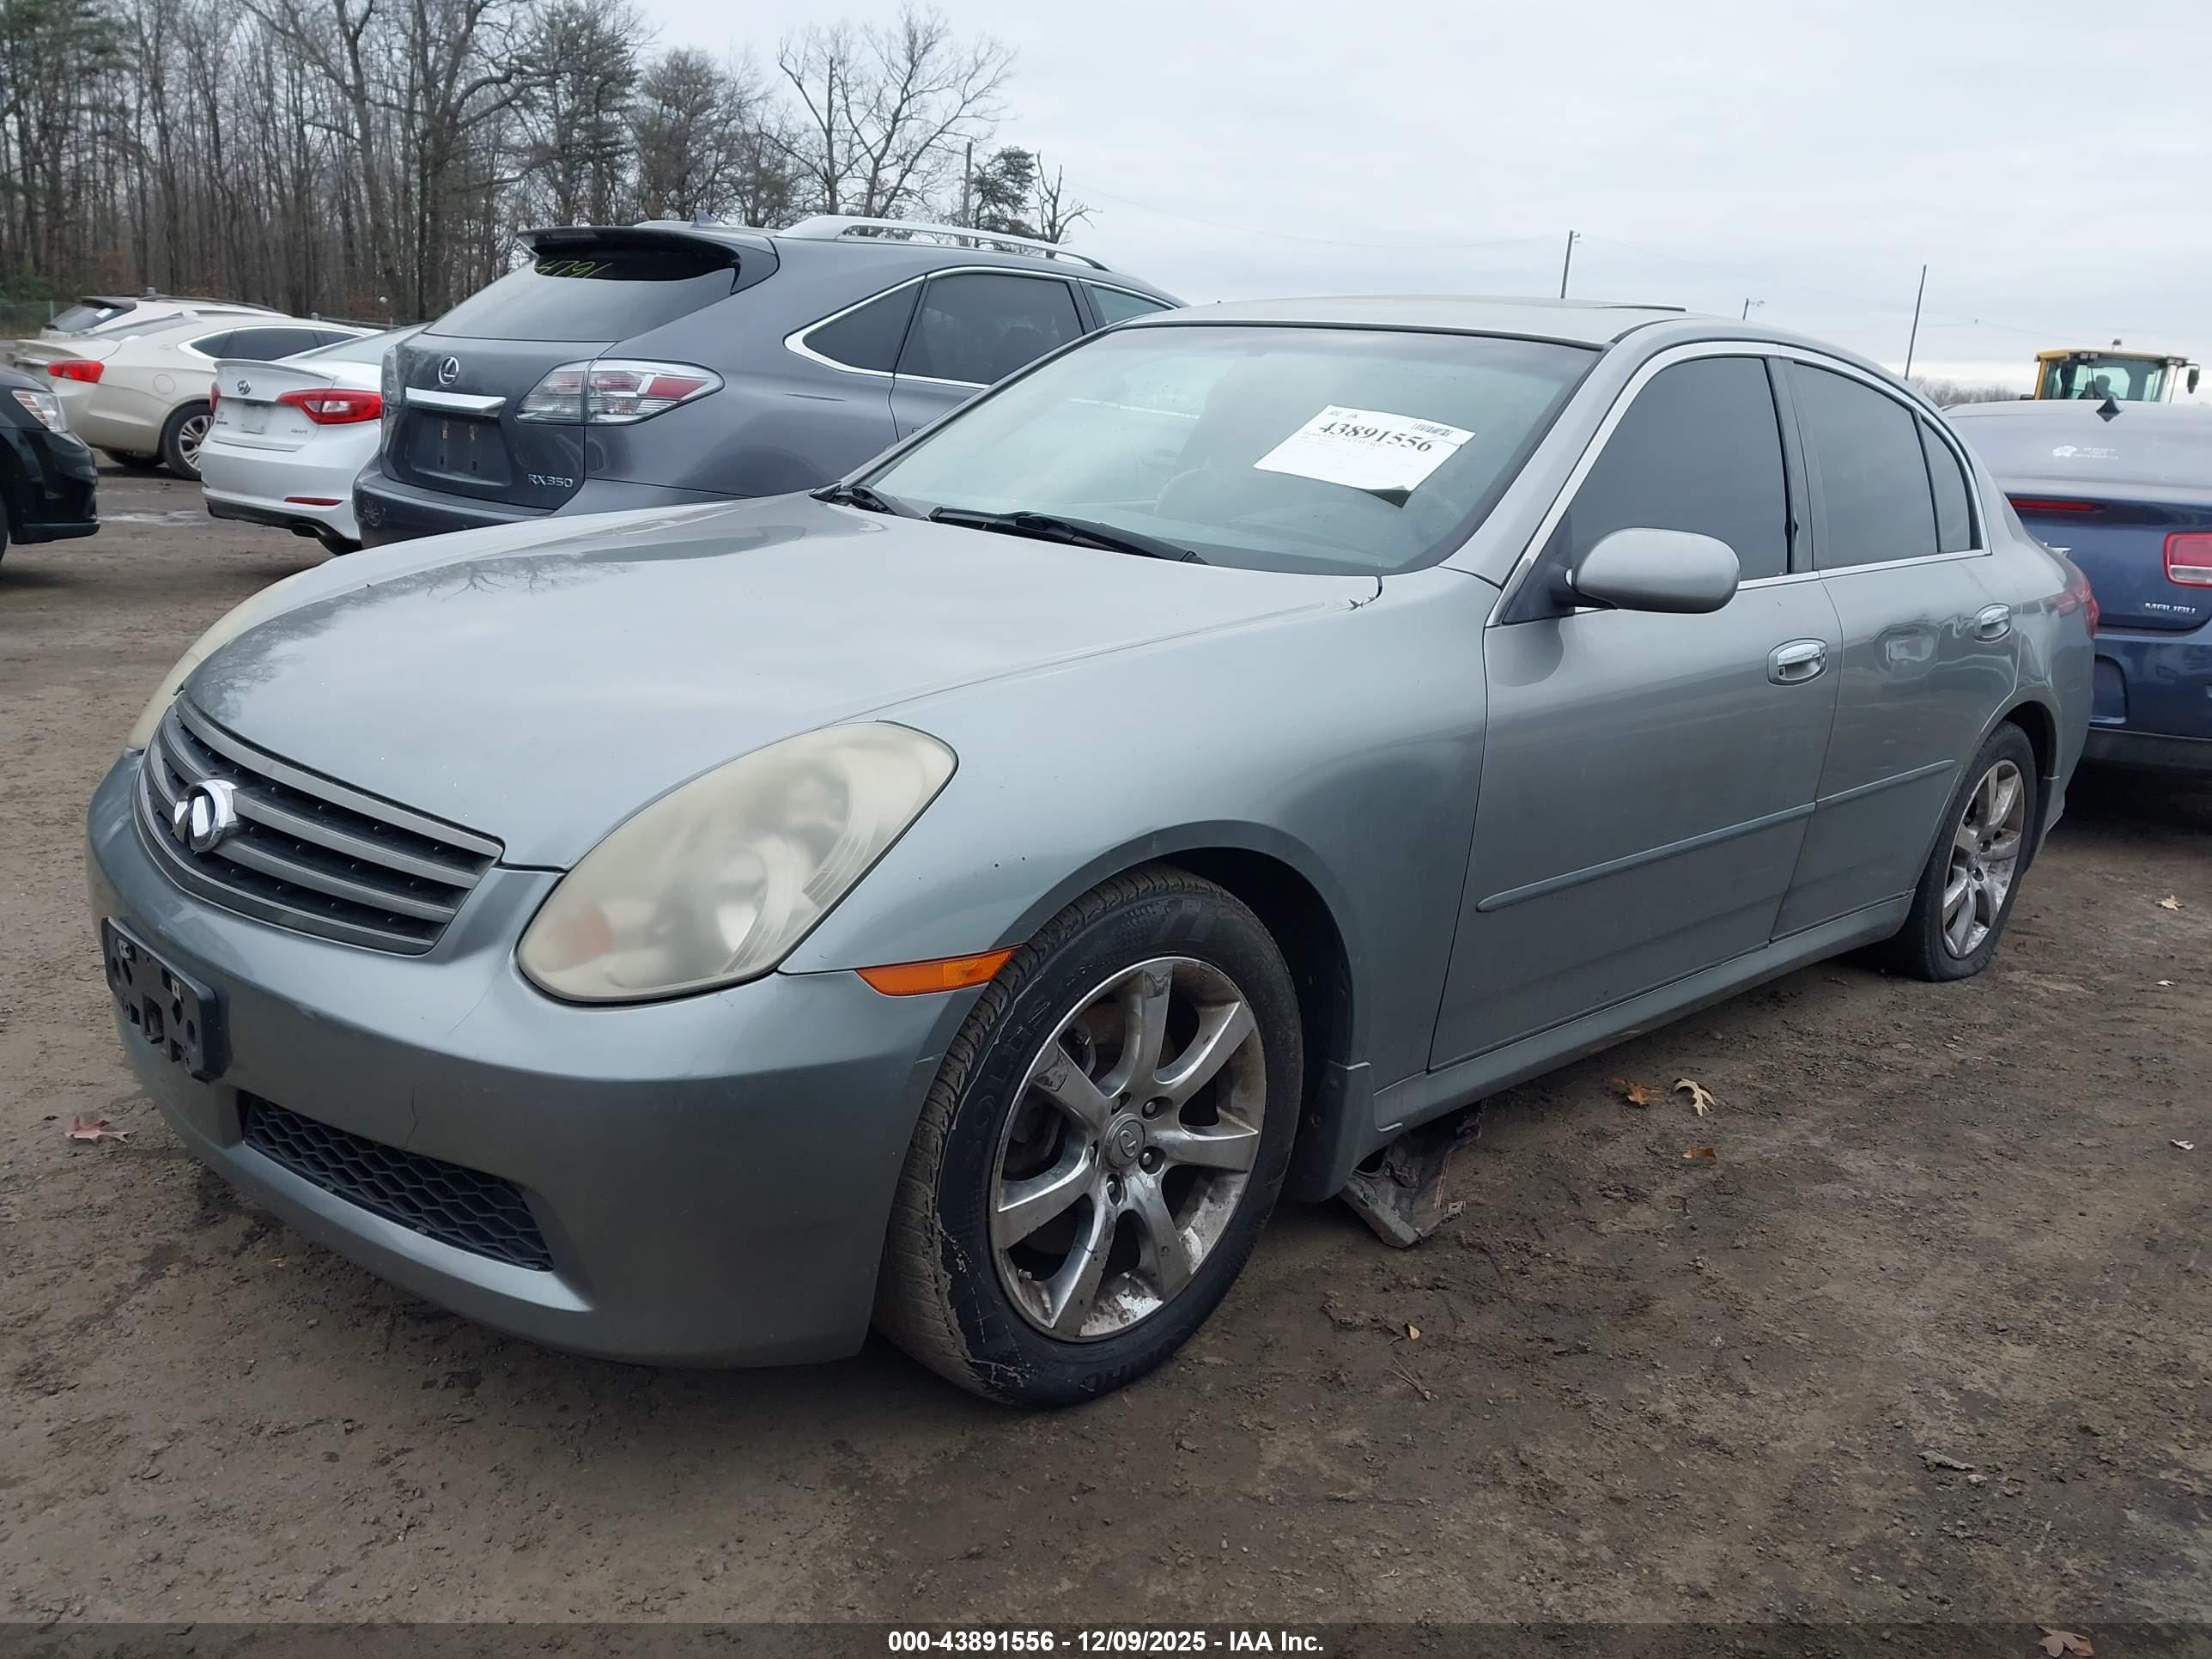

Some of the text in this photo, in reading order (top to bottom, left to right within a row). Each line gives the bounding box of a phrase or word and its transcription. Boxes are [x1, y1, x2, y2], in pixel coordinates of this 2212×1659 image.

[1318, 421, 1437, 453] 43891556
[527, 473, 574, 488] RX350
[2144, 602, 2197, 615] MALIBU
